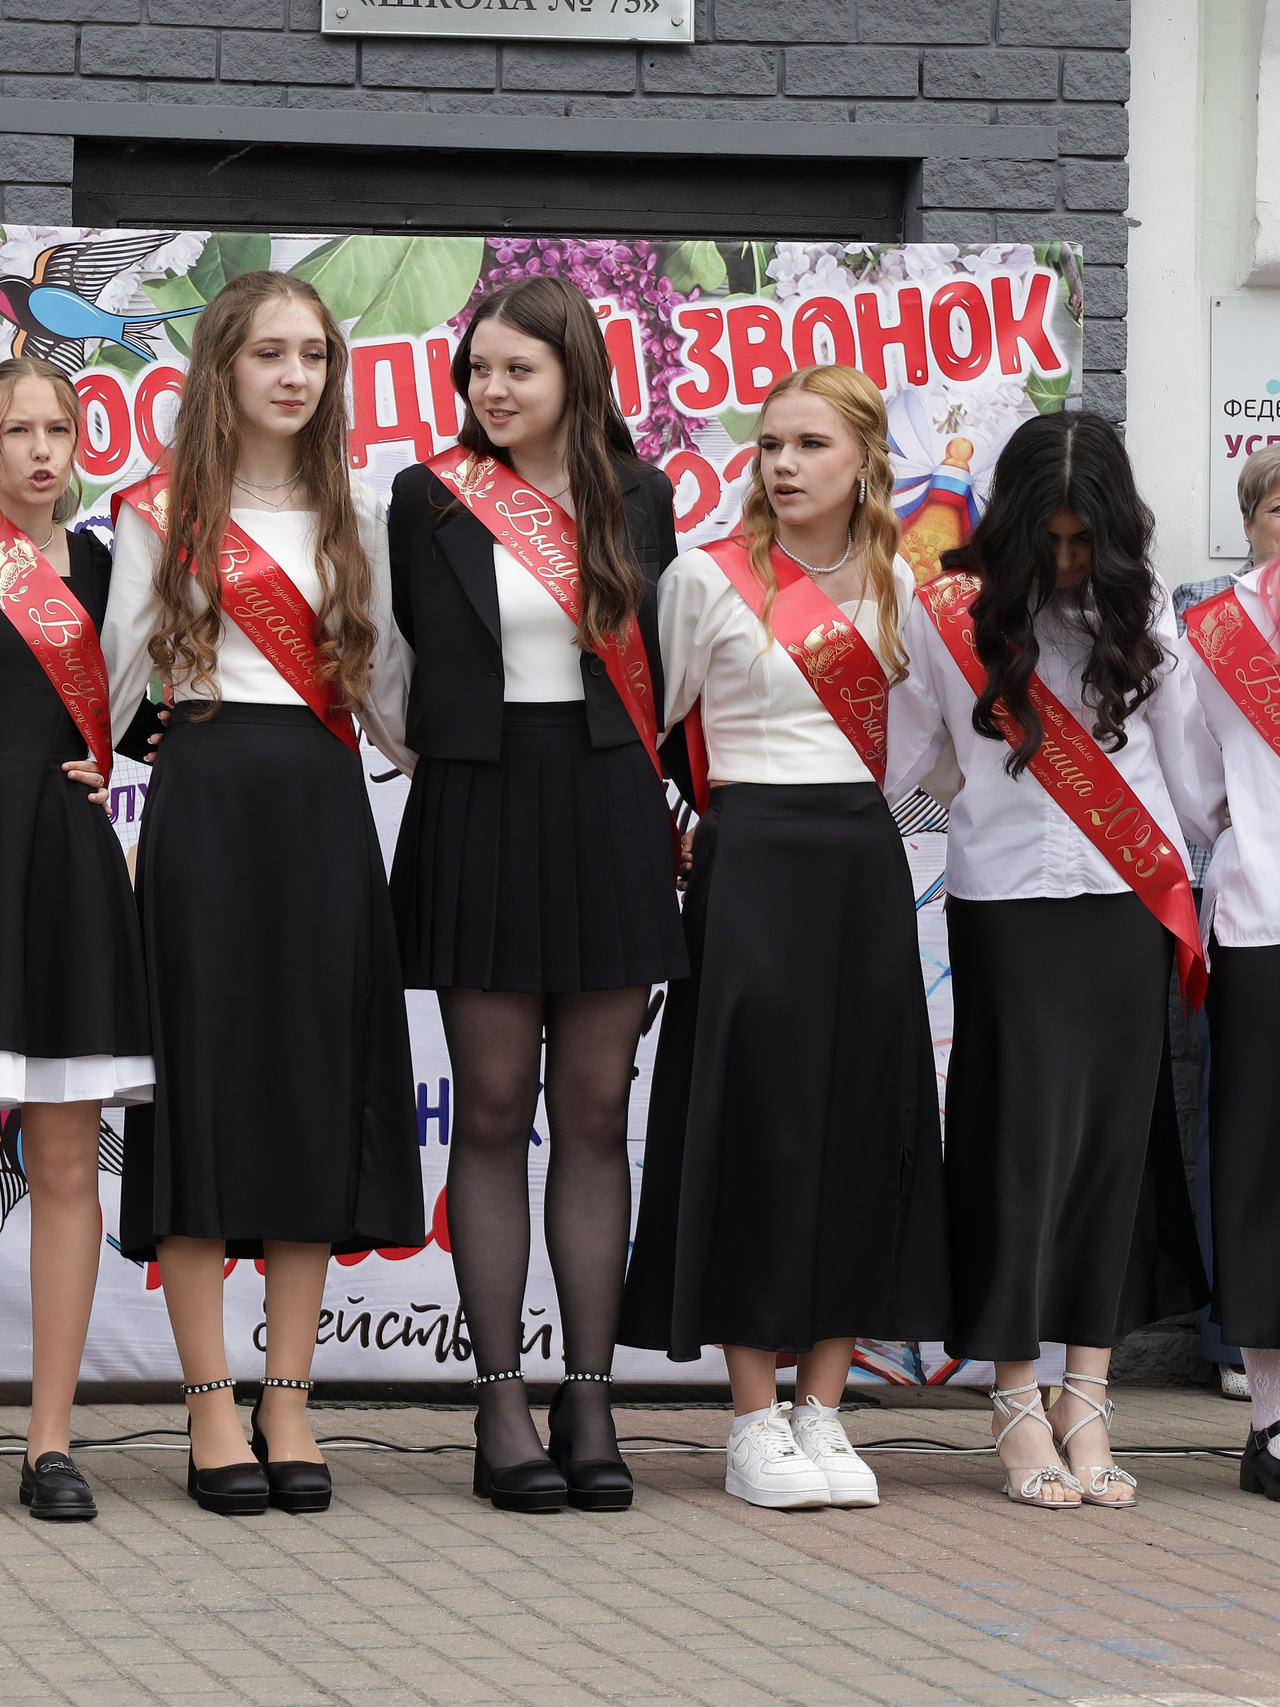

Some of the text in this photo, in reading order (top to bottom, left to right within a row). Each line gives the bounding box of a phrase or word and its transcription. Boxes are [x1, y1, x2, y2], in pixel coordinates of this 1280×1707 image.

[676, 272, 1062, 410] ЗВОНОК
[259, 565, 300, 616] Богданова
[1061, 725, 1095, 763] Лейла
[1083, 787, 1172, 878] 2025
